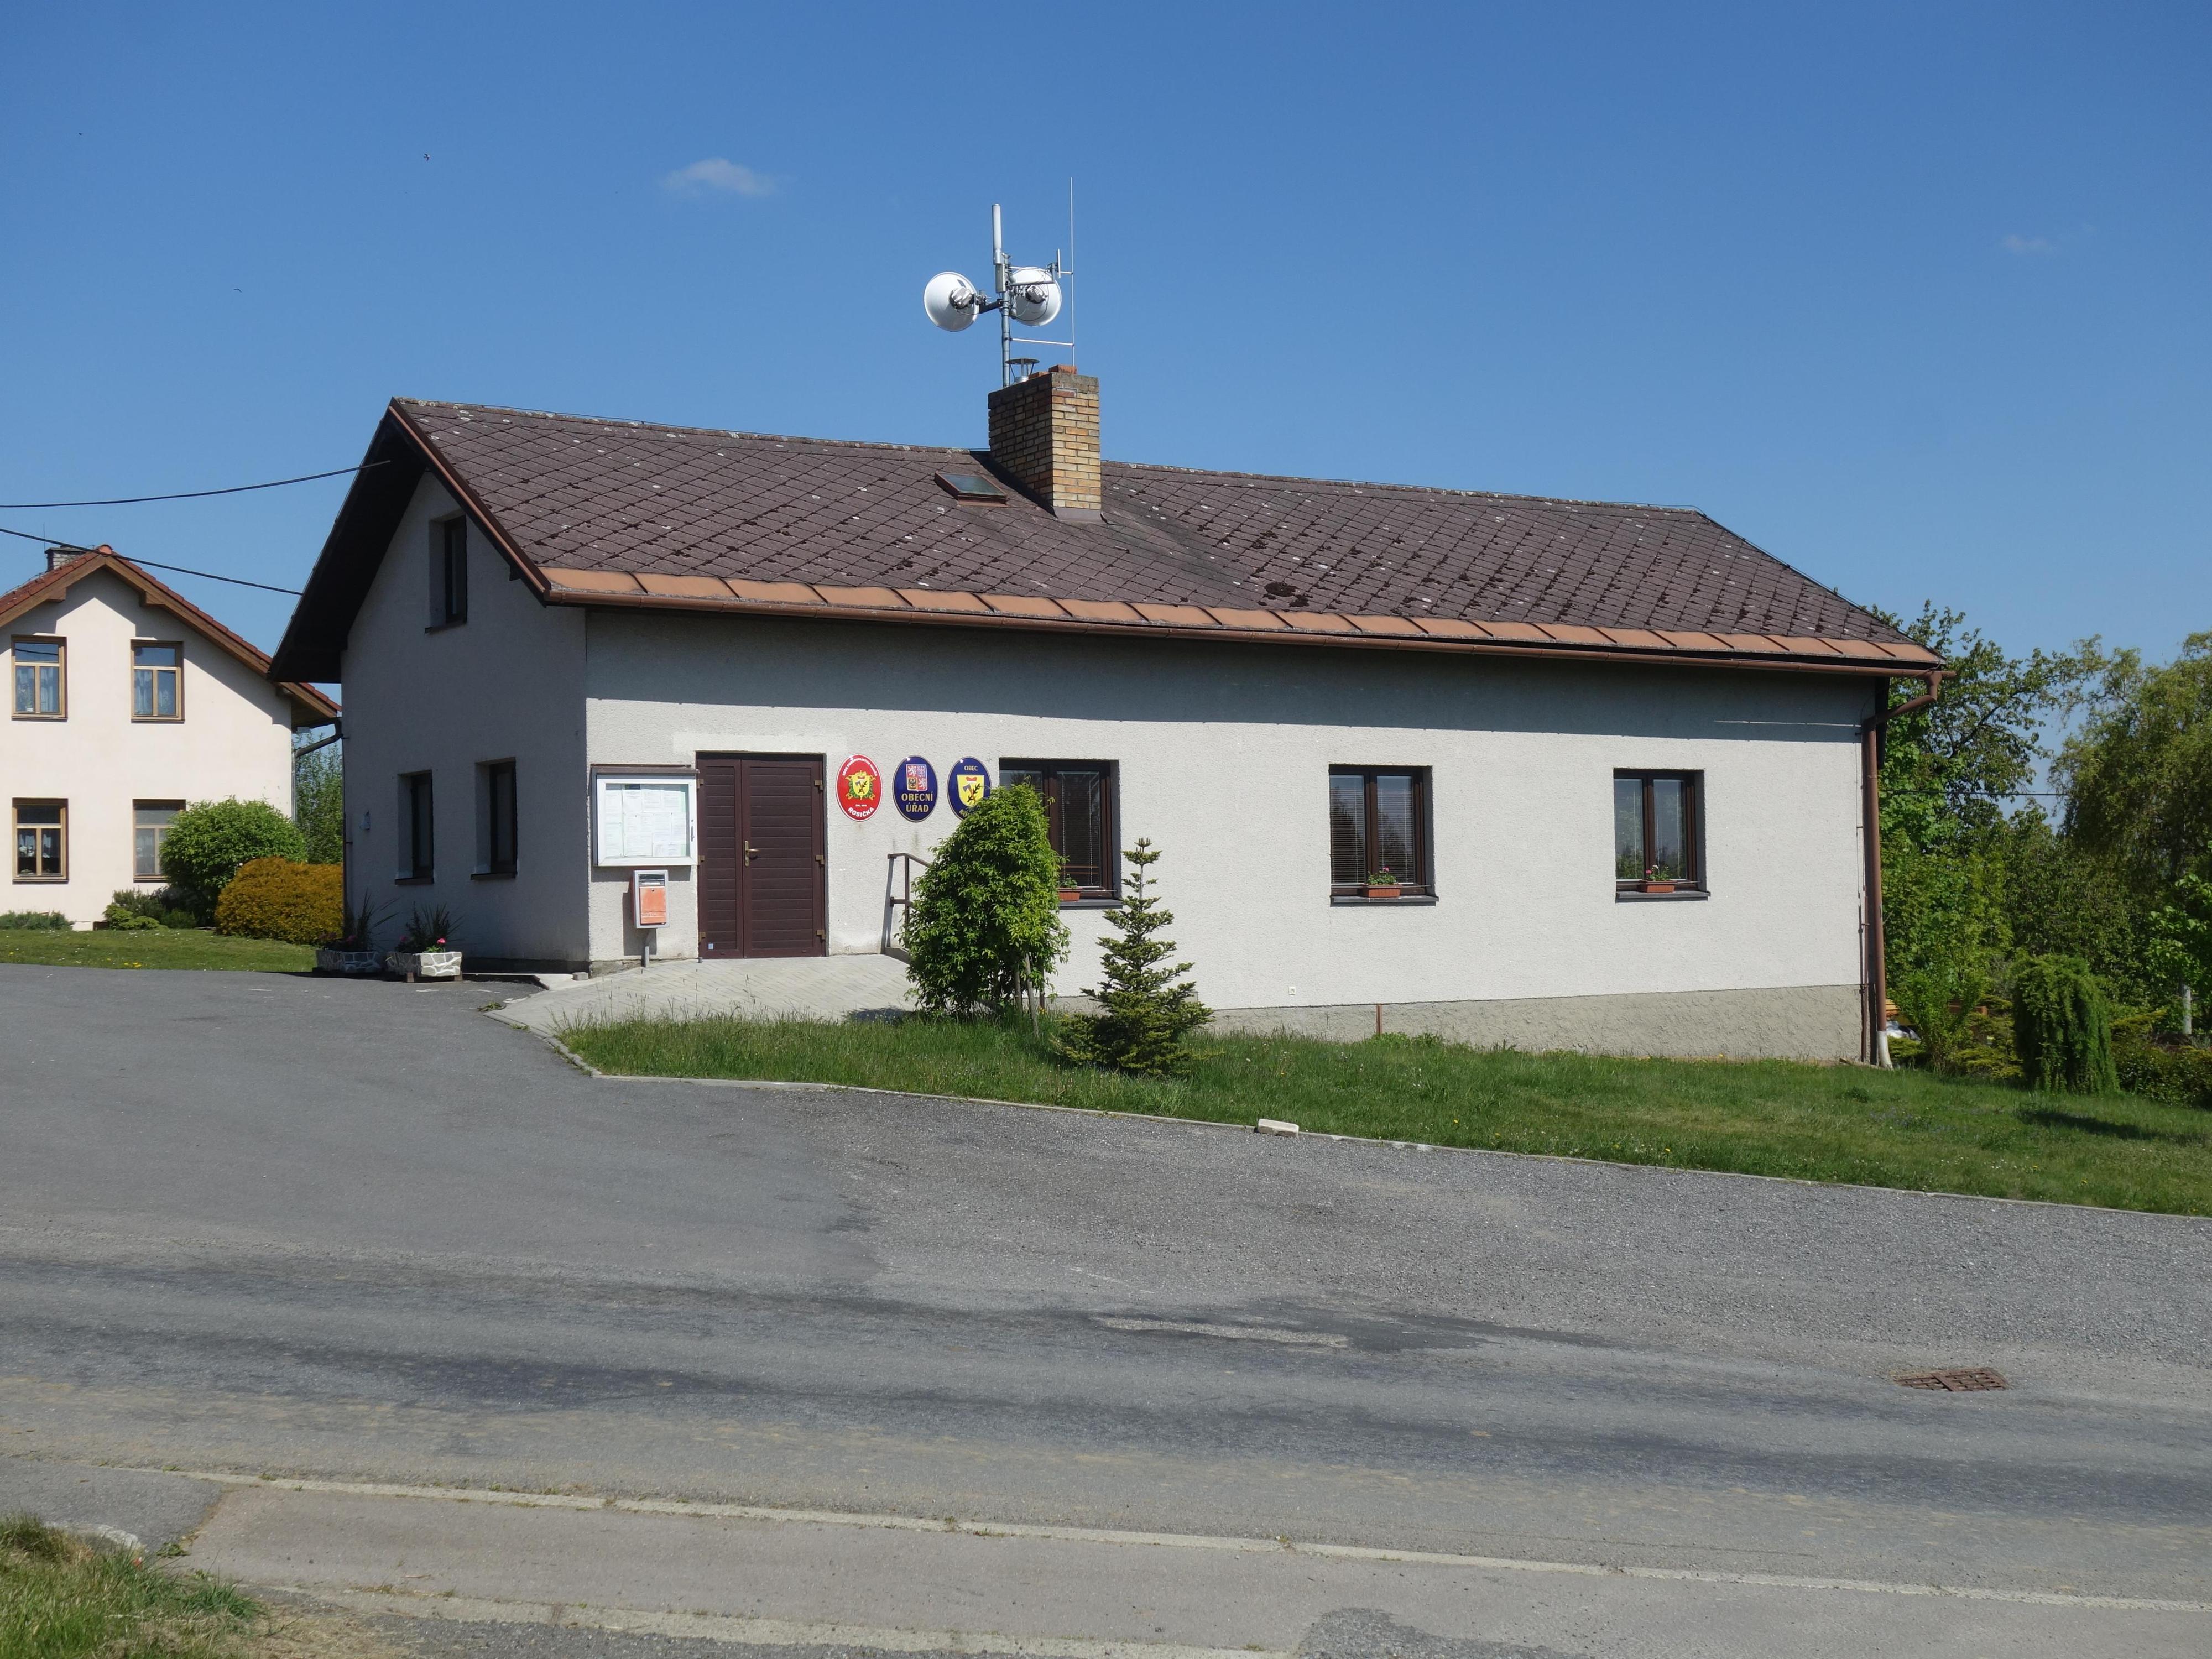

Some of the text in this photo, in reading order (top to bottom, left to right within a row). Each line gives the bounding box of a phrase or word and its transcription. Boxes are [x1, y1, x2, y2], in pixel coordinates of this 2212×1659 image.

[901, 791, 933, 801] OBECNÍ
[848, 807, 874, 817] ROSIČKA
[906, 802, 929, 812] ÚŘAD
